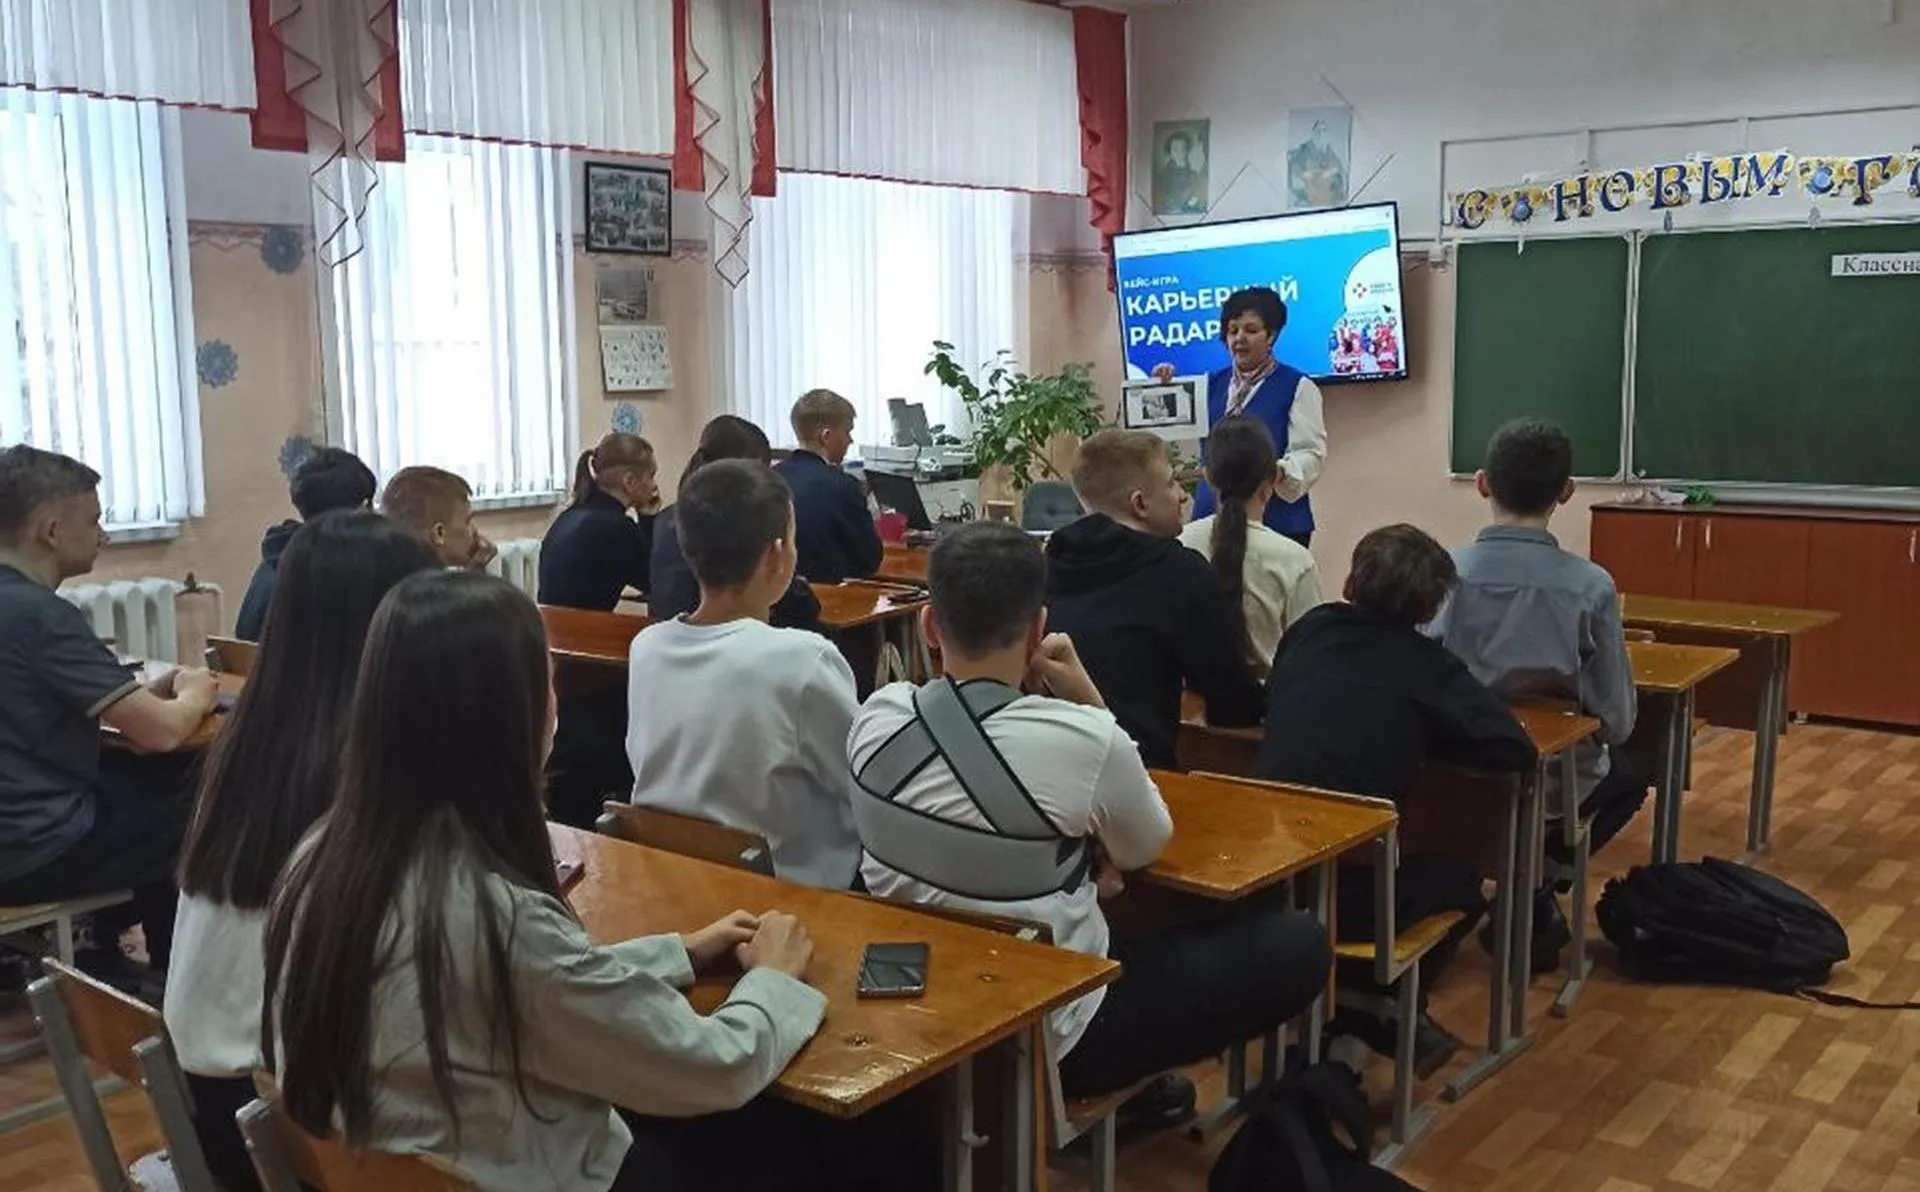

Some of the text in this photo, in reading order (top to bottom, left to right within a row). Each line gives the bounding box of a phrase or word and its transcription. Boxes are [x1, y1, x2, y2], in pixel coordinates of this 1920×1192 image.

[1553, 154, 1789, 222] НОВЫМ
[1126, 275, 1298, 316] КАРЬЕРЙ
[1130, 319, 1221, 347] РАДАР
